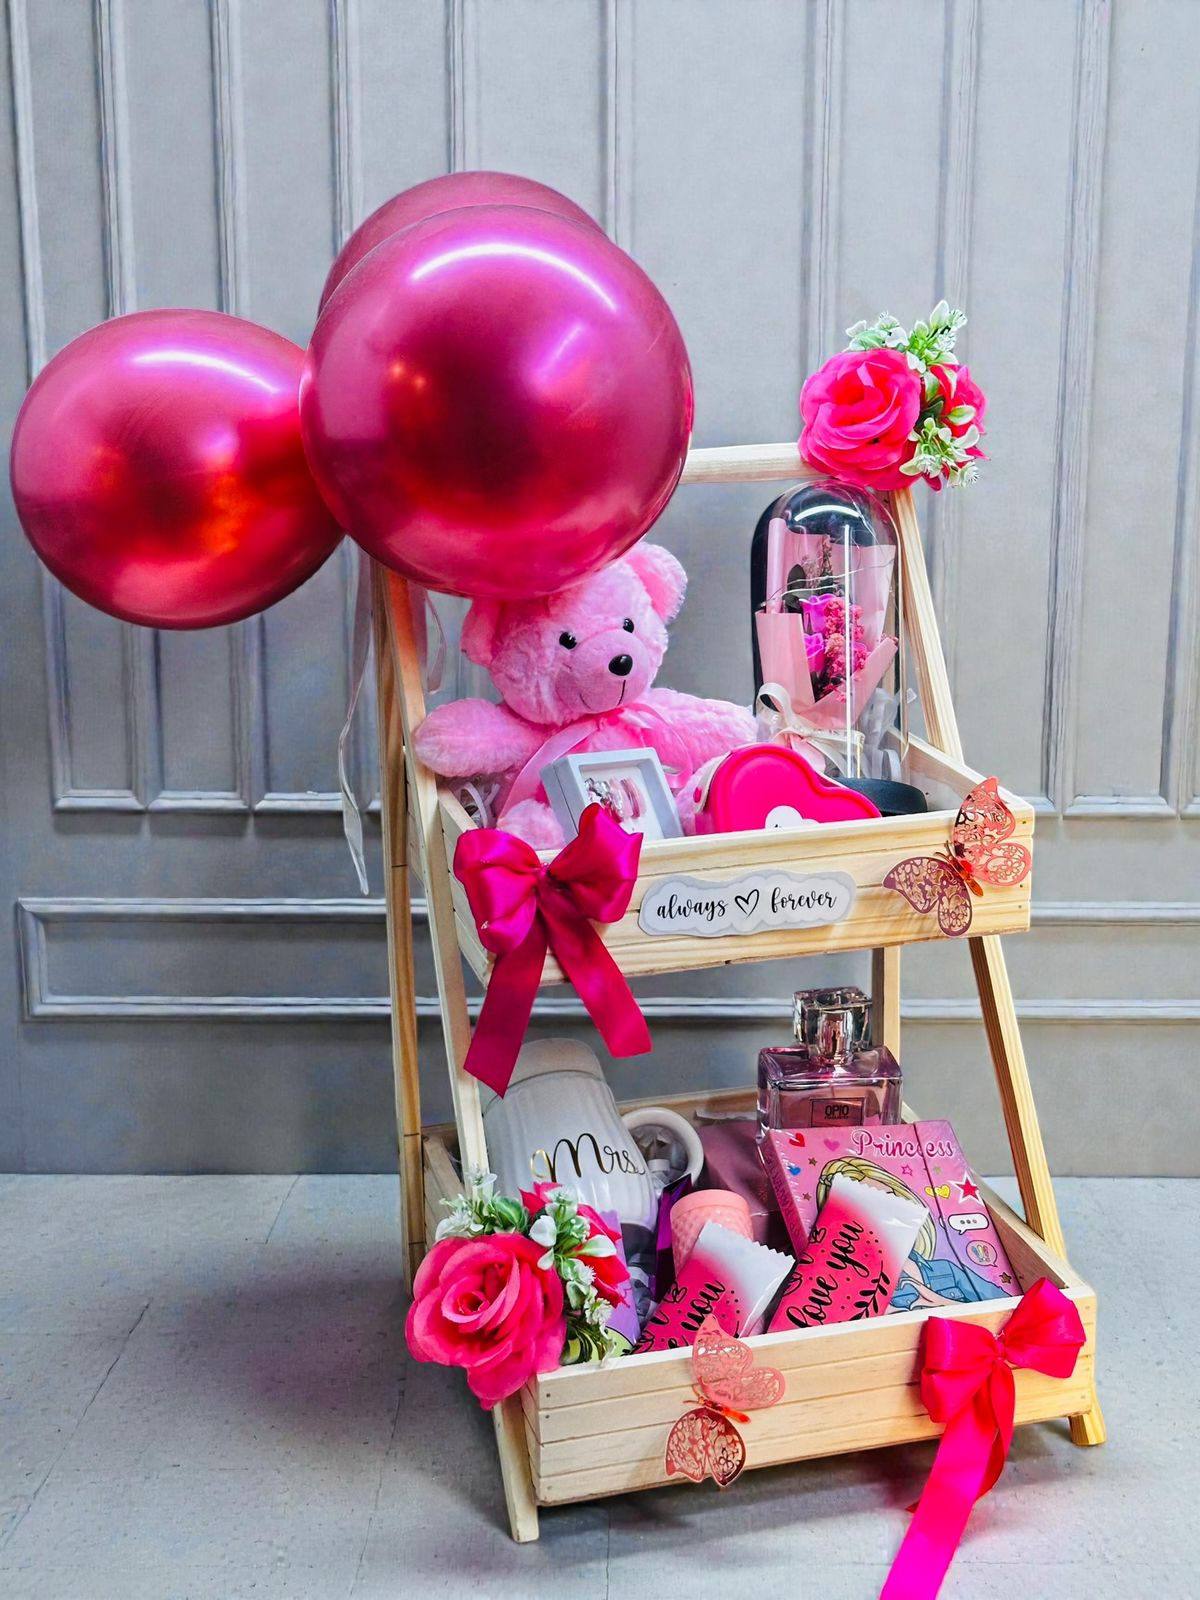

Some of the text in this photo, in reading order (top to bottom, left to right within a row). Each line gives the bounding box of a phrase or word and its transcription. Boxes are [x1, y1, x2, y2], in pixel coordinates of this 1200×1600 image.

[657, 887, 837, 921] always forever
[825, 1104, 849, 1117] OPIO
[786, 1274, 839, 1327] love
[826, 1220, 869, 1278] you
